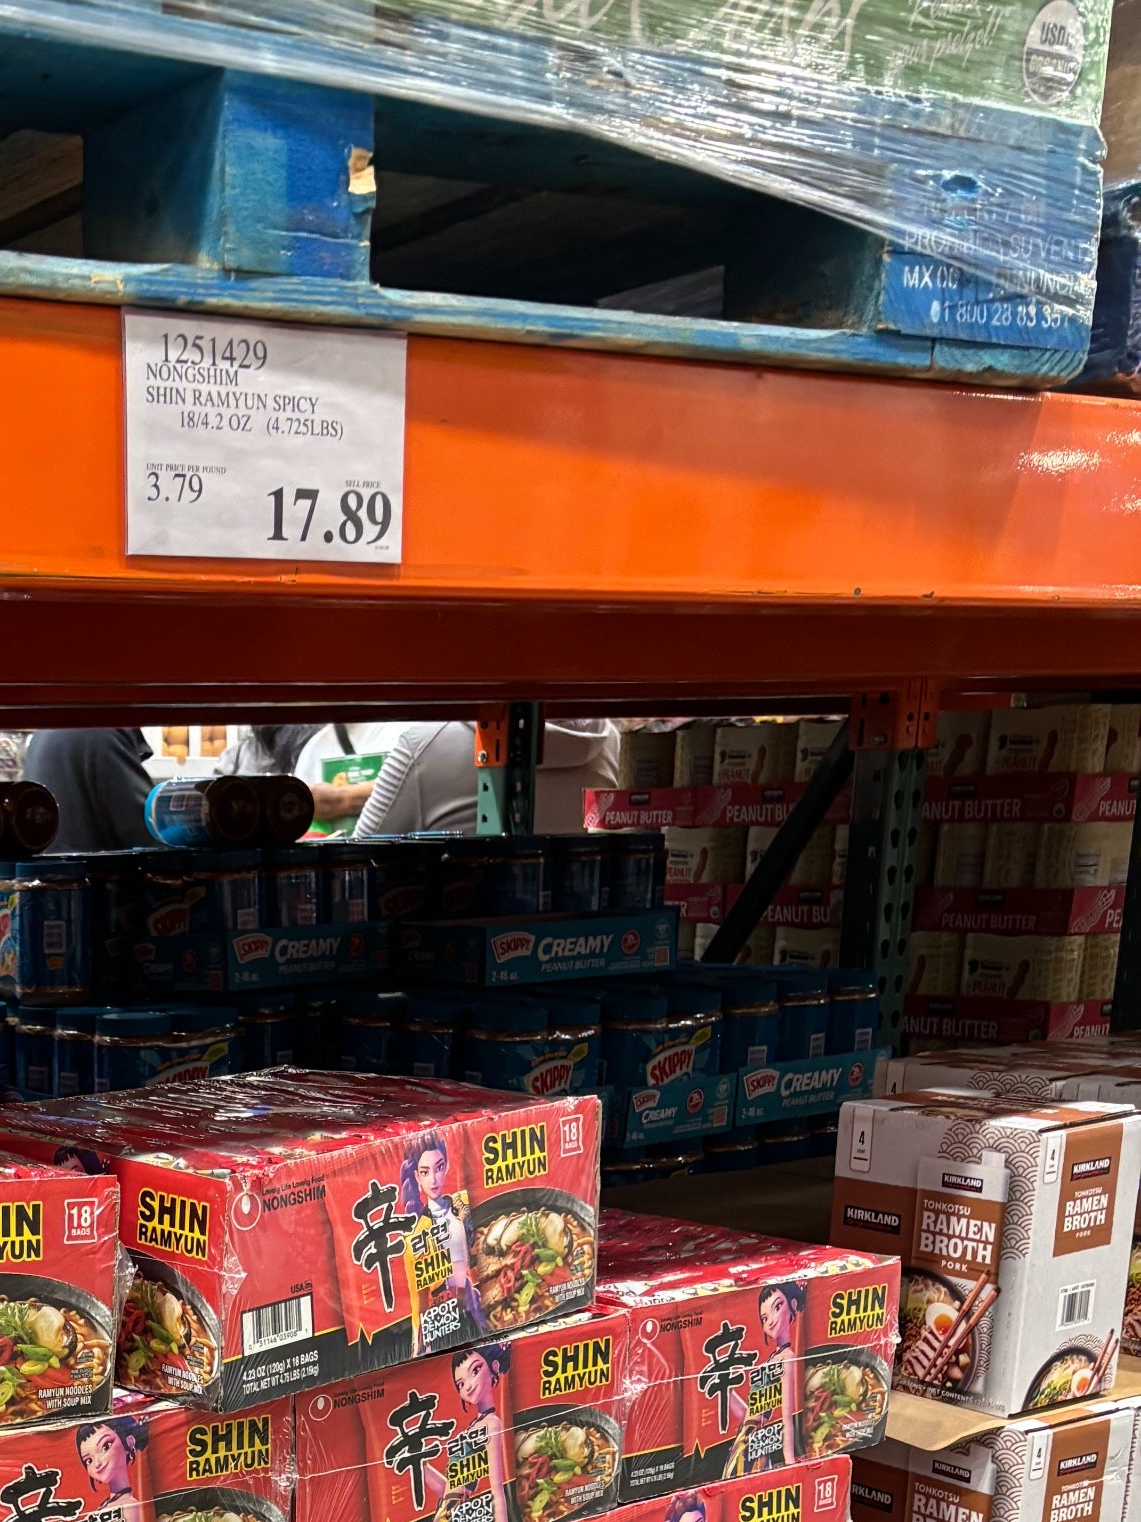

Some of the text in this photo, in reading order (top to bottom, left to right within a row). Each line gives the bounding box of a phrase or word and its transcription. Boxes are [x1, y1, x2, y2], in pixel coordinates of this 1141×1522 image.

[957, 301, 987, 323] 800
[161, 332, 267, 370] 1251429
[146, 363, 239, 387] NONGSHIM
[145, 386, 319, 414] SHIN RAMYUN SPICY
[180, 411, 344, 441] 18/4.2 OZ (4.725LBS)
[146, 463, 226, 474] UNIT PRICE PER POUND
[147, 472, 203, 503] 3.79
[362, 481, 381, 489] PRICE
[267, 486, 392, 545] 17.89
[605, 810, 673, 825] PEANUT BUTTER
[726, 804, 772, 823] PEANUT
[964, 799, 1021, 819] BUTTER
[942, 913, 1036, 931] PEANUT BUTTER
[274, 937, 342, 963] CREAMY
[537, 934, 614, 961] CREAMY
[942, 1019, 999, 1039] BUTTER
[649, 1048, 693, 1087] SKIPPY
[531, 1064, 572, 1096] SKIPPY
[780, 1068, 842, 1097] CREAMY
[641, 1107, 678, 1124] CREAMY
[563, 1123, 578, 1142] 18
[858, 1130, 866, 1146] 4
[483, 1122, 547, 1169] SHIN
[484, 1152, 548, 1187] RAMYUN
[1072, 1158, 1110, 1174] KIRKLAND
[943, 1173, 982, 1188] KIRKLAND
[262, 1185, 326, 1213] NONGSHIM
[923, 1199, 972, 1216] TONKOTSU
[1064, 1194, 1109, 1218] RAMEN
[69, 1206, 91, 1228] 18
[138, 1189, 210, 1237] SHIN
[846, 1207, 900, 1227] KIRKLAND
[1062, 1209, 1107, 1233] BROTH
[71, 1227, 91, 1236] BAGS
[921, 1211, 997, 1243] RAMEN
[138, 1221, 209, 1260] RAMYUN
[352, 1180, 417, 1312] 辛
[919, 1232, 993, 1264] BROTH
[941, 1259, 969, 1272] PORK
[830, 1285, 887, 1318] SHIN
[829, 1310, 884, 1338] RAMYUN
[541, 1337, 612, 1377] SHIN
[38, 1384, 93, 1399] RAMYUN NOODLES
[541, 1366, 612, 1398] RAMYUN
[46, 1396, 92, 1409] WITH SOUP MIX
[187, 1416, 270, 1459] SHIN
[187, 1448, 270, 1480] RAMYUN
[934, 1461, 970, 1478] KIRKLAND
[1060, 1453, 1097, 1470] KIRKLAND
[817, 1480, 833, 1500] 18
[914, 1482, 960, 1503] TONKOTSU
[1052, 1486, 1095, 1508] RAMEN
[739, 1483, 802, 1522] SHIN
